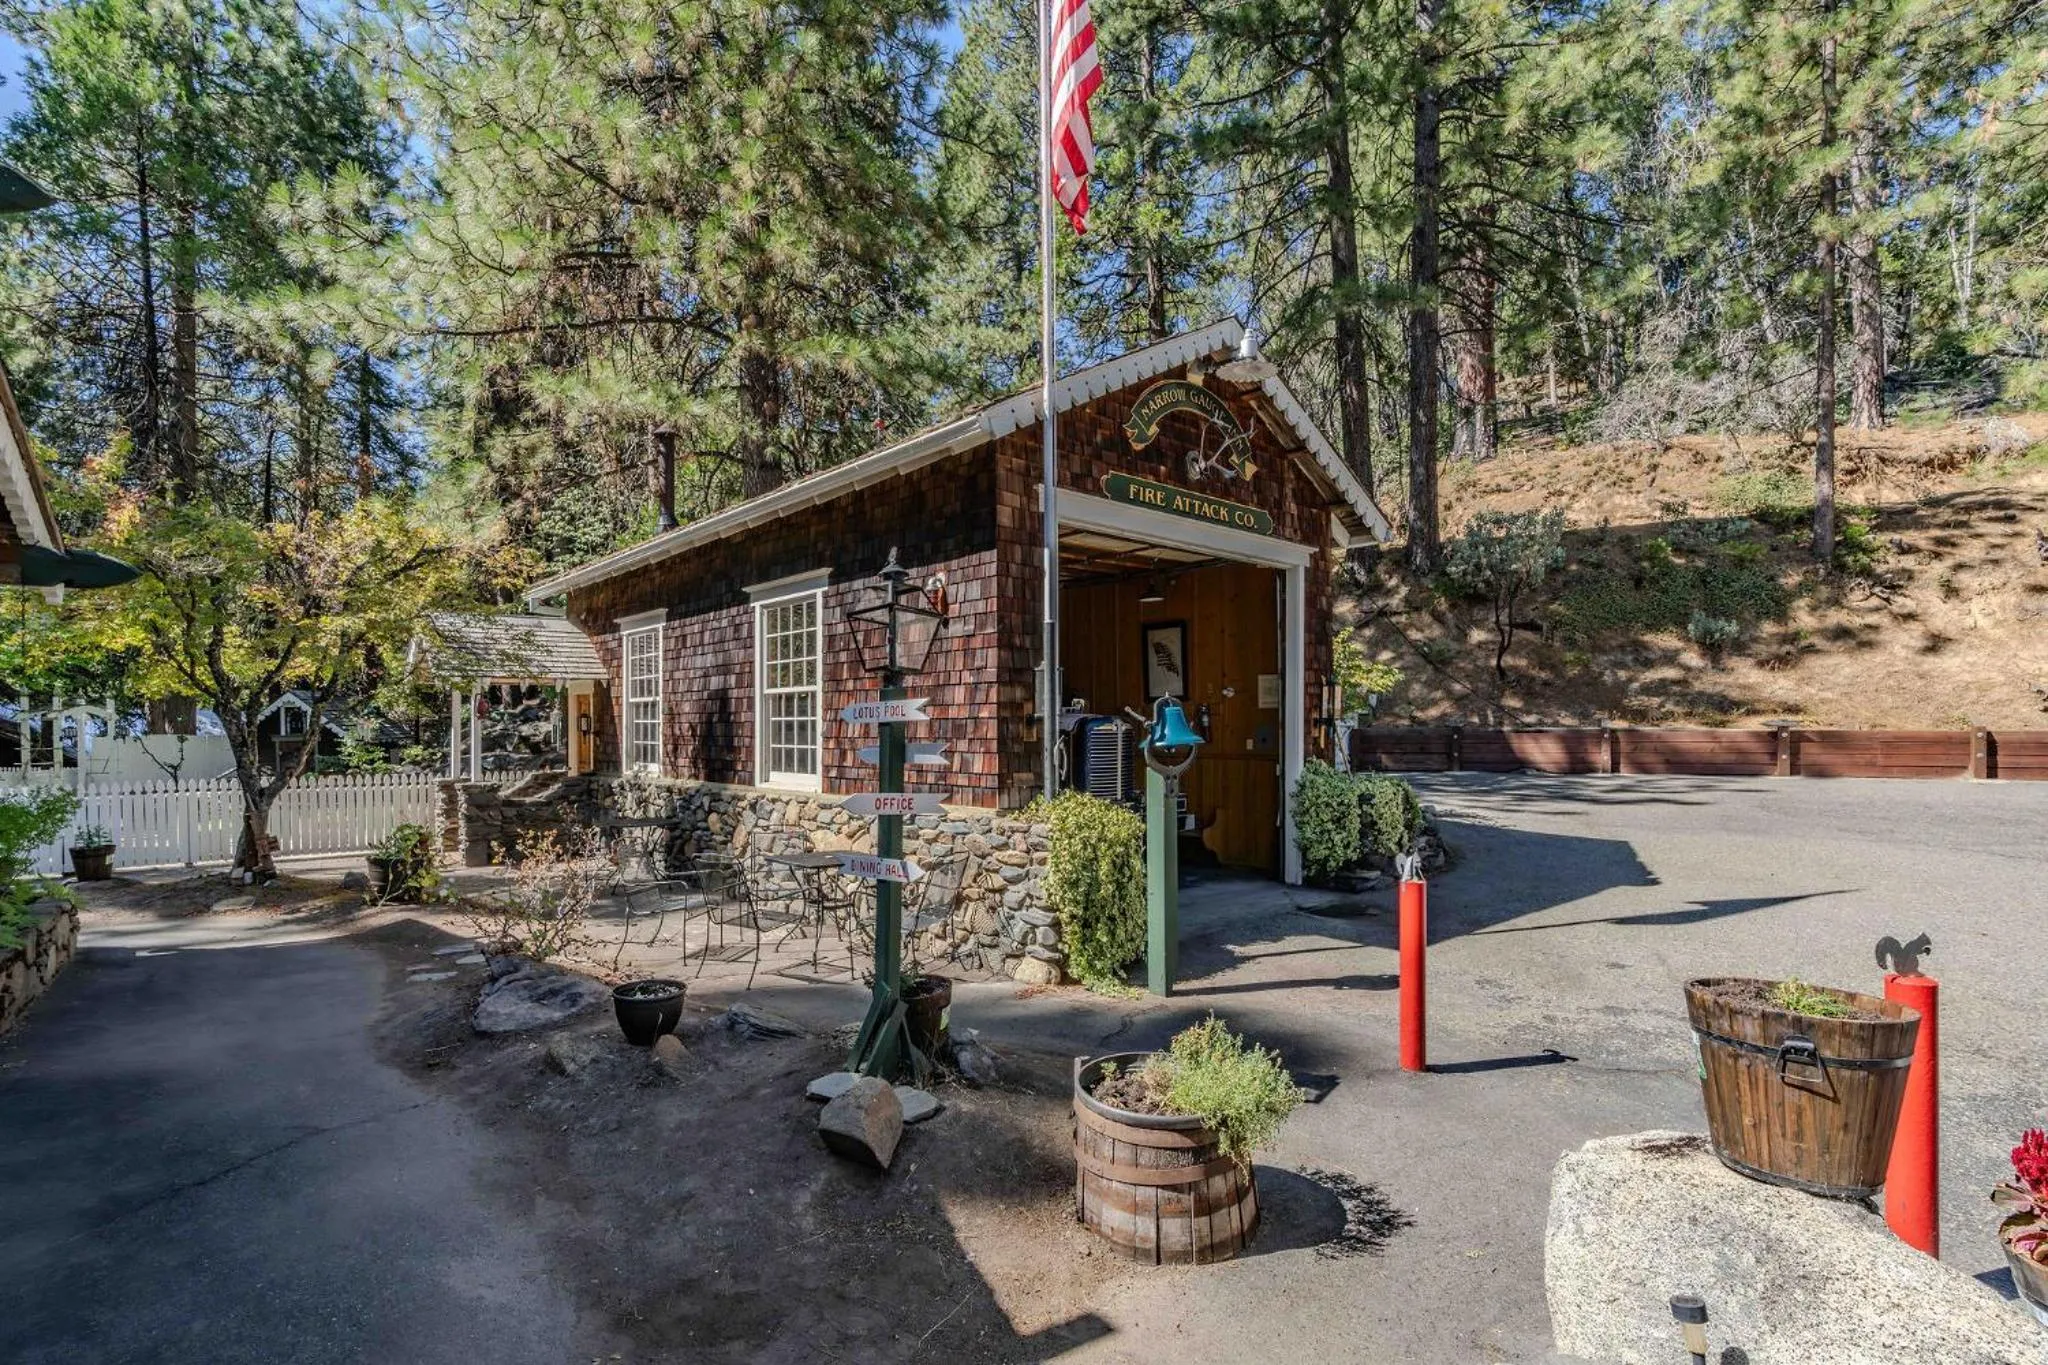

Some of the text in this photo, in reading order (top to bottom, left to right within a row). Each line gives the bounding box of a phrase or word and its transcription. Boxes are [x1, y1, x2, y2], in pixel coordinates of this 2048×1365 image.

[1141, 388, 1186, 421] NARROW
[1129, 484, 1258, 529] FIRE ATTACK CO.
[853, 704, 906, 720] LOTUS POOL
[874, 798, 914, 811] OFFICE
[851, 859, 881, 875] DINING
